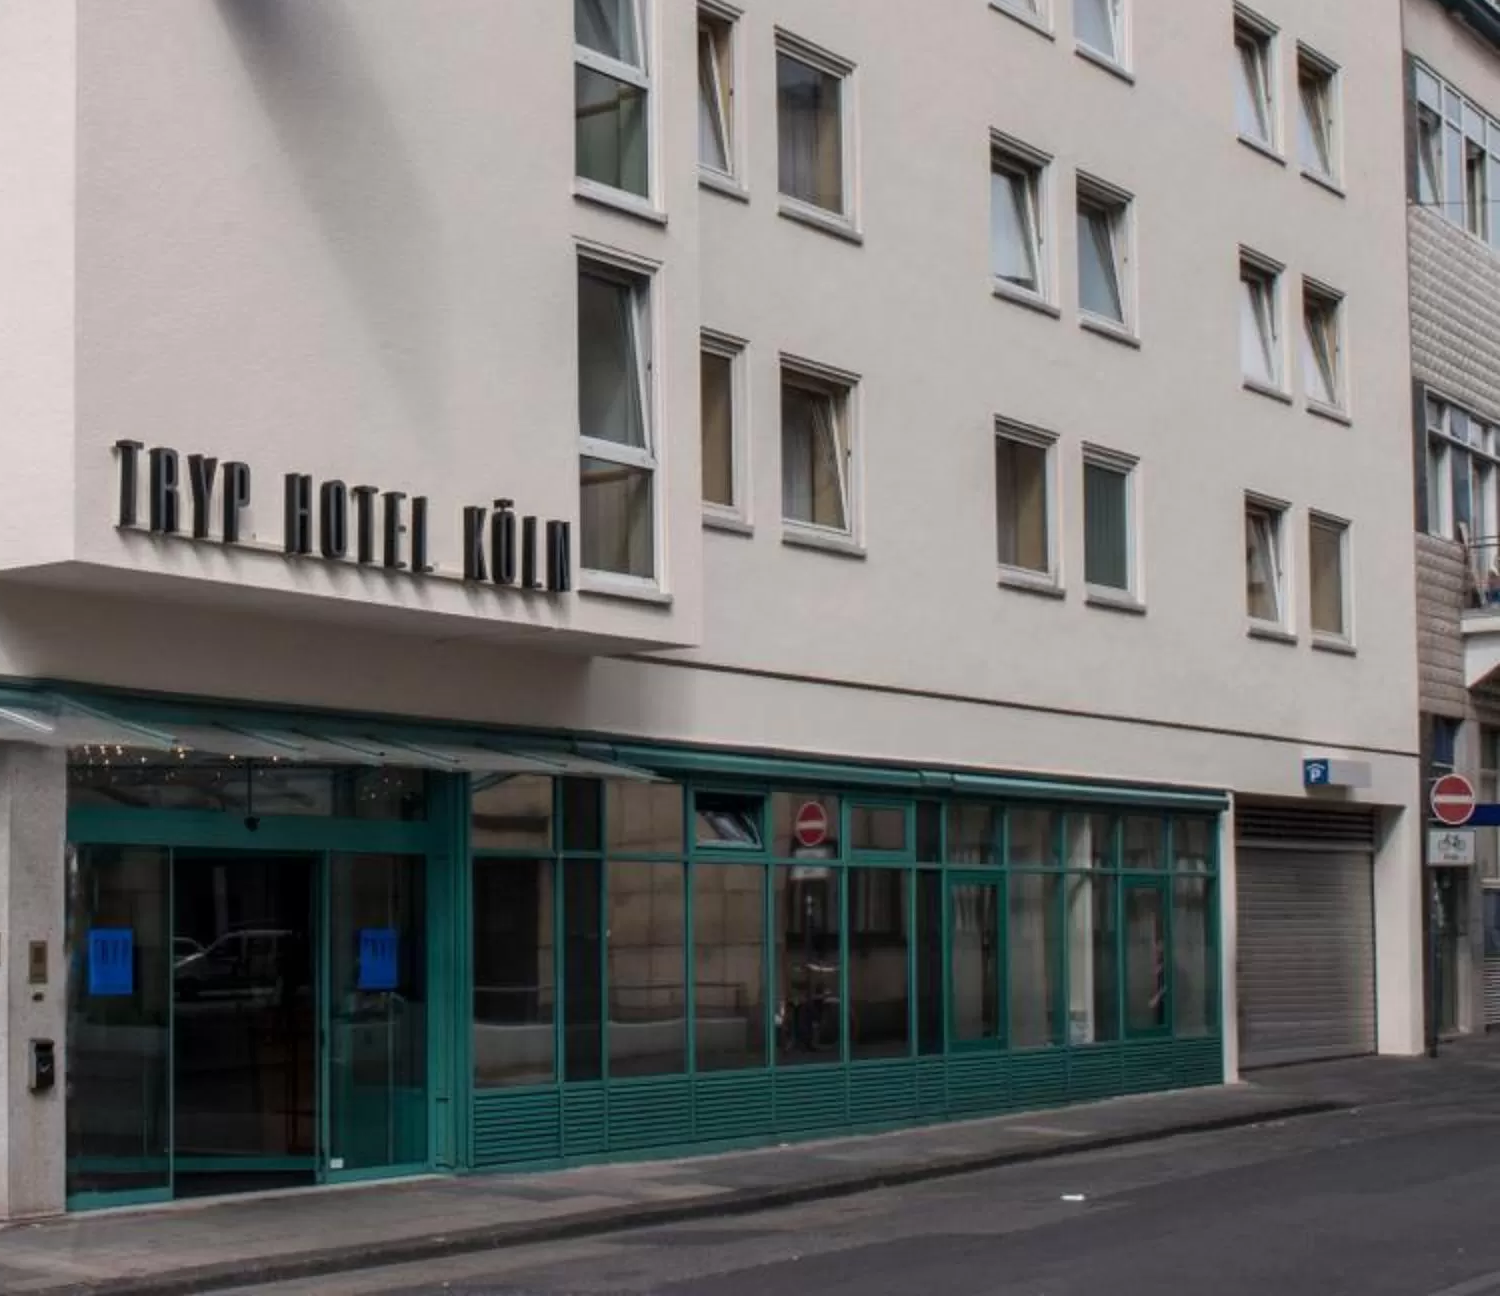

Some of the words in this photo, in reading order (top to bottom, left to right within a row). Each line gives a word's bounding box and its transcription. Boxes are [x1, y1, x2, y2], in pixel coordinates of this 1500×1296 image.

[114, 438, 251, 544] TRYP
[284, 471, 435, 574] HOTEL
[463, 497, 571, 593] KÖLN
